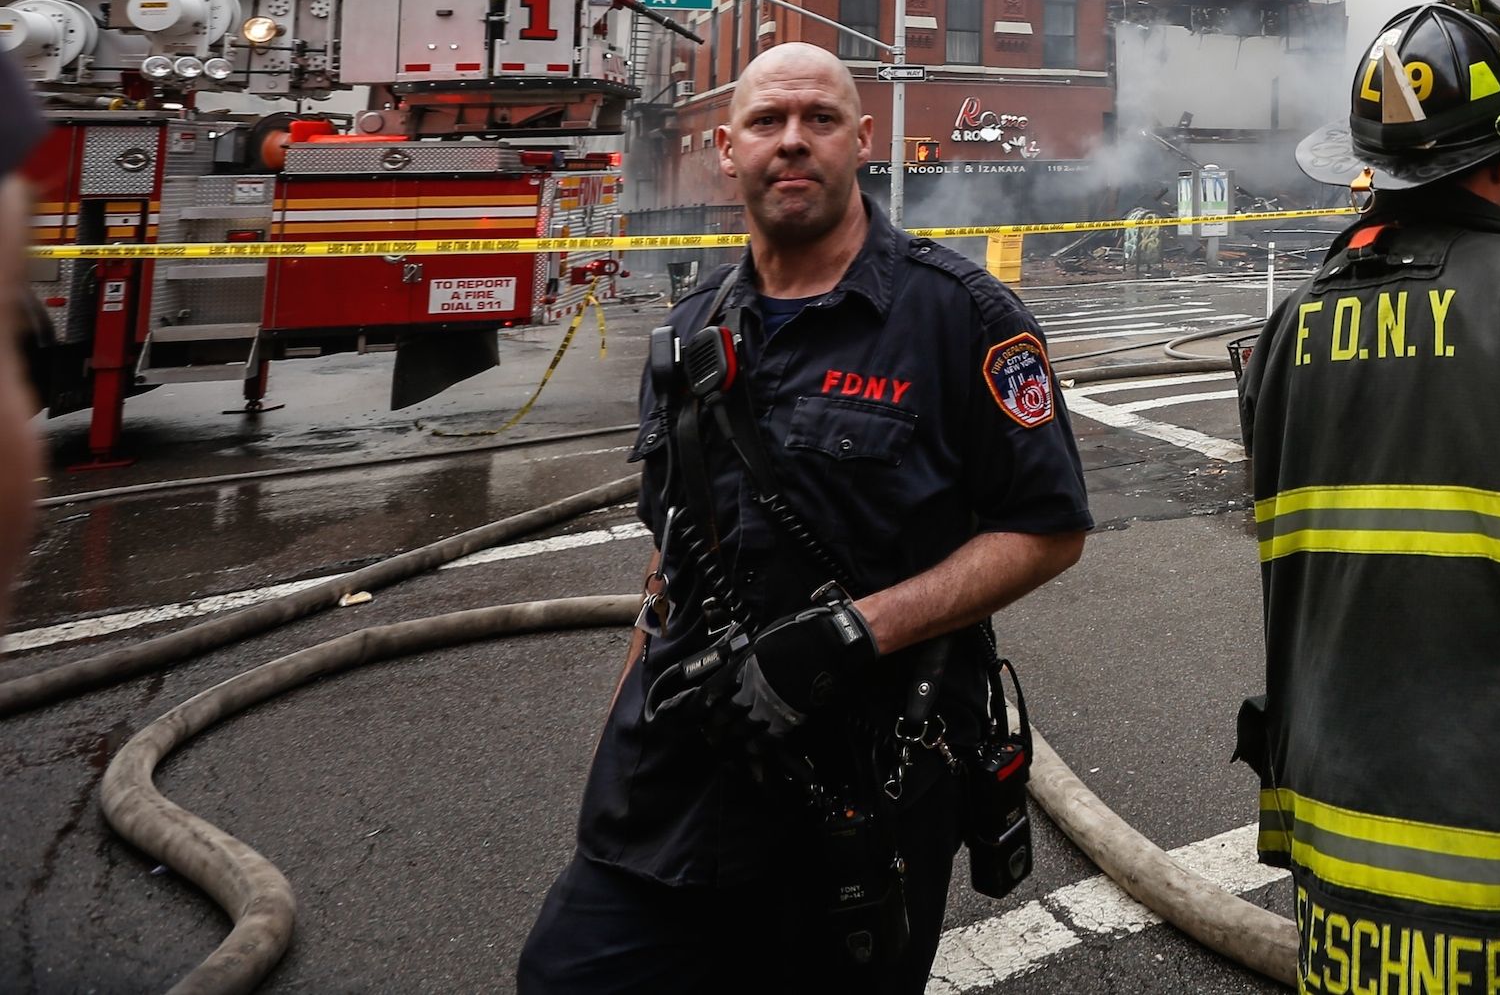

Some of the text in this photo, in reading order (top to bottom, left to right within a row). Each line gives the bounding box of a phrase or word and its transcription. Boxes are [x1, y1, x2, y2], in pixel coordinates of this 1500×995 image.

[1360, 60, 1434, 102] L 9
[951, 130, 962, 141] &
[869, 166, 894, 174] EAS
[908, 166, 960, 174] NOODLE
[964, 164, 973, 173] &
[434, 279, 512, 289] TO REPORT
[450, 290, 494, 300] A FIRE
[441, 301, 502, 311] DIAL 911
[1006, 350, 1030, 366] CITY OF
[991, 356, 1004, 375] FIRE
[1004, 357, 1037, 376] NEW YORK
[821, 369, 912, 404] FDNY
[685, 661, 702, 674] FIRM
